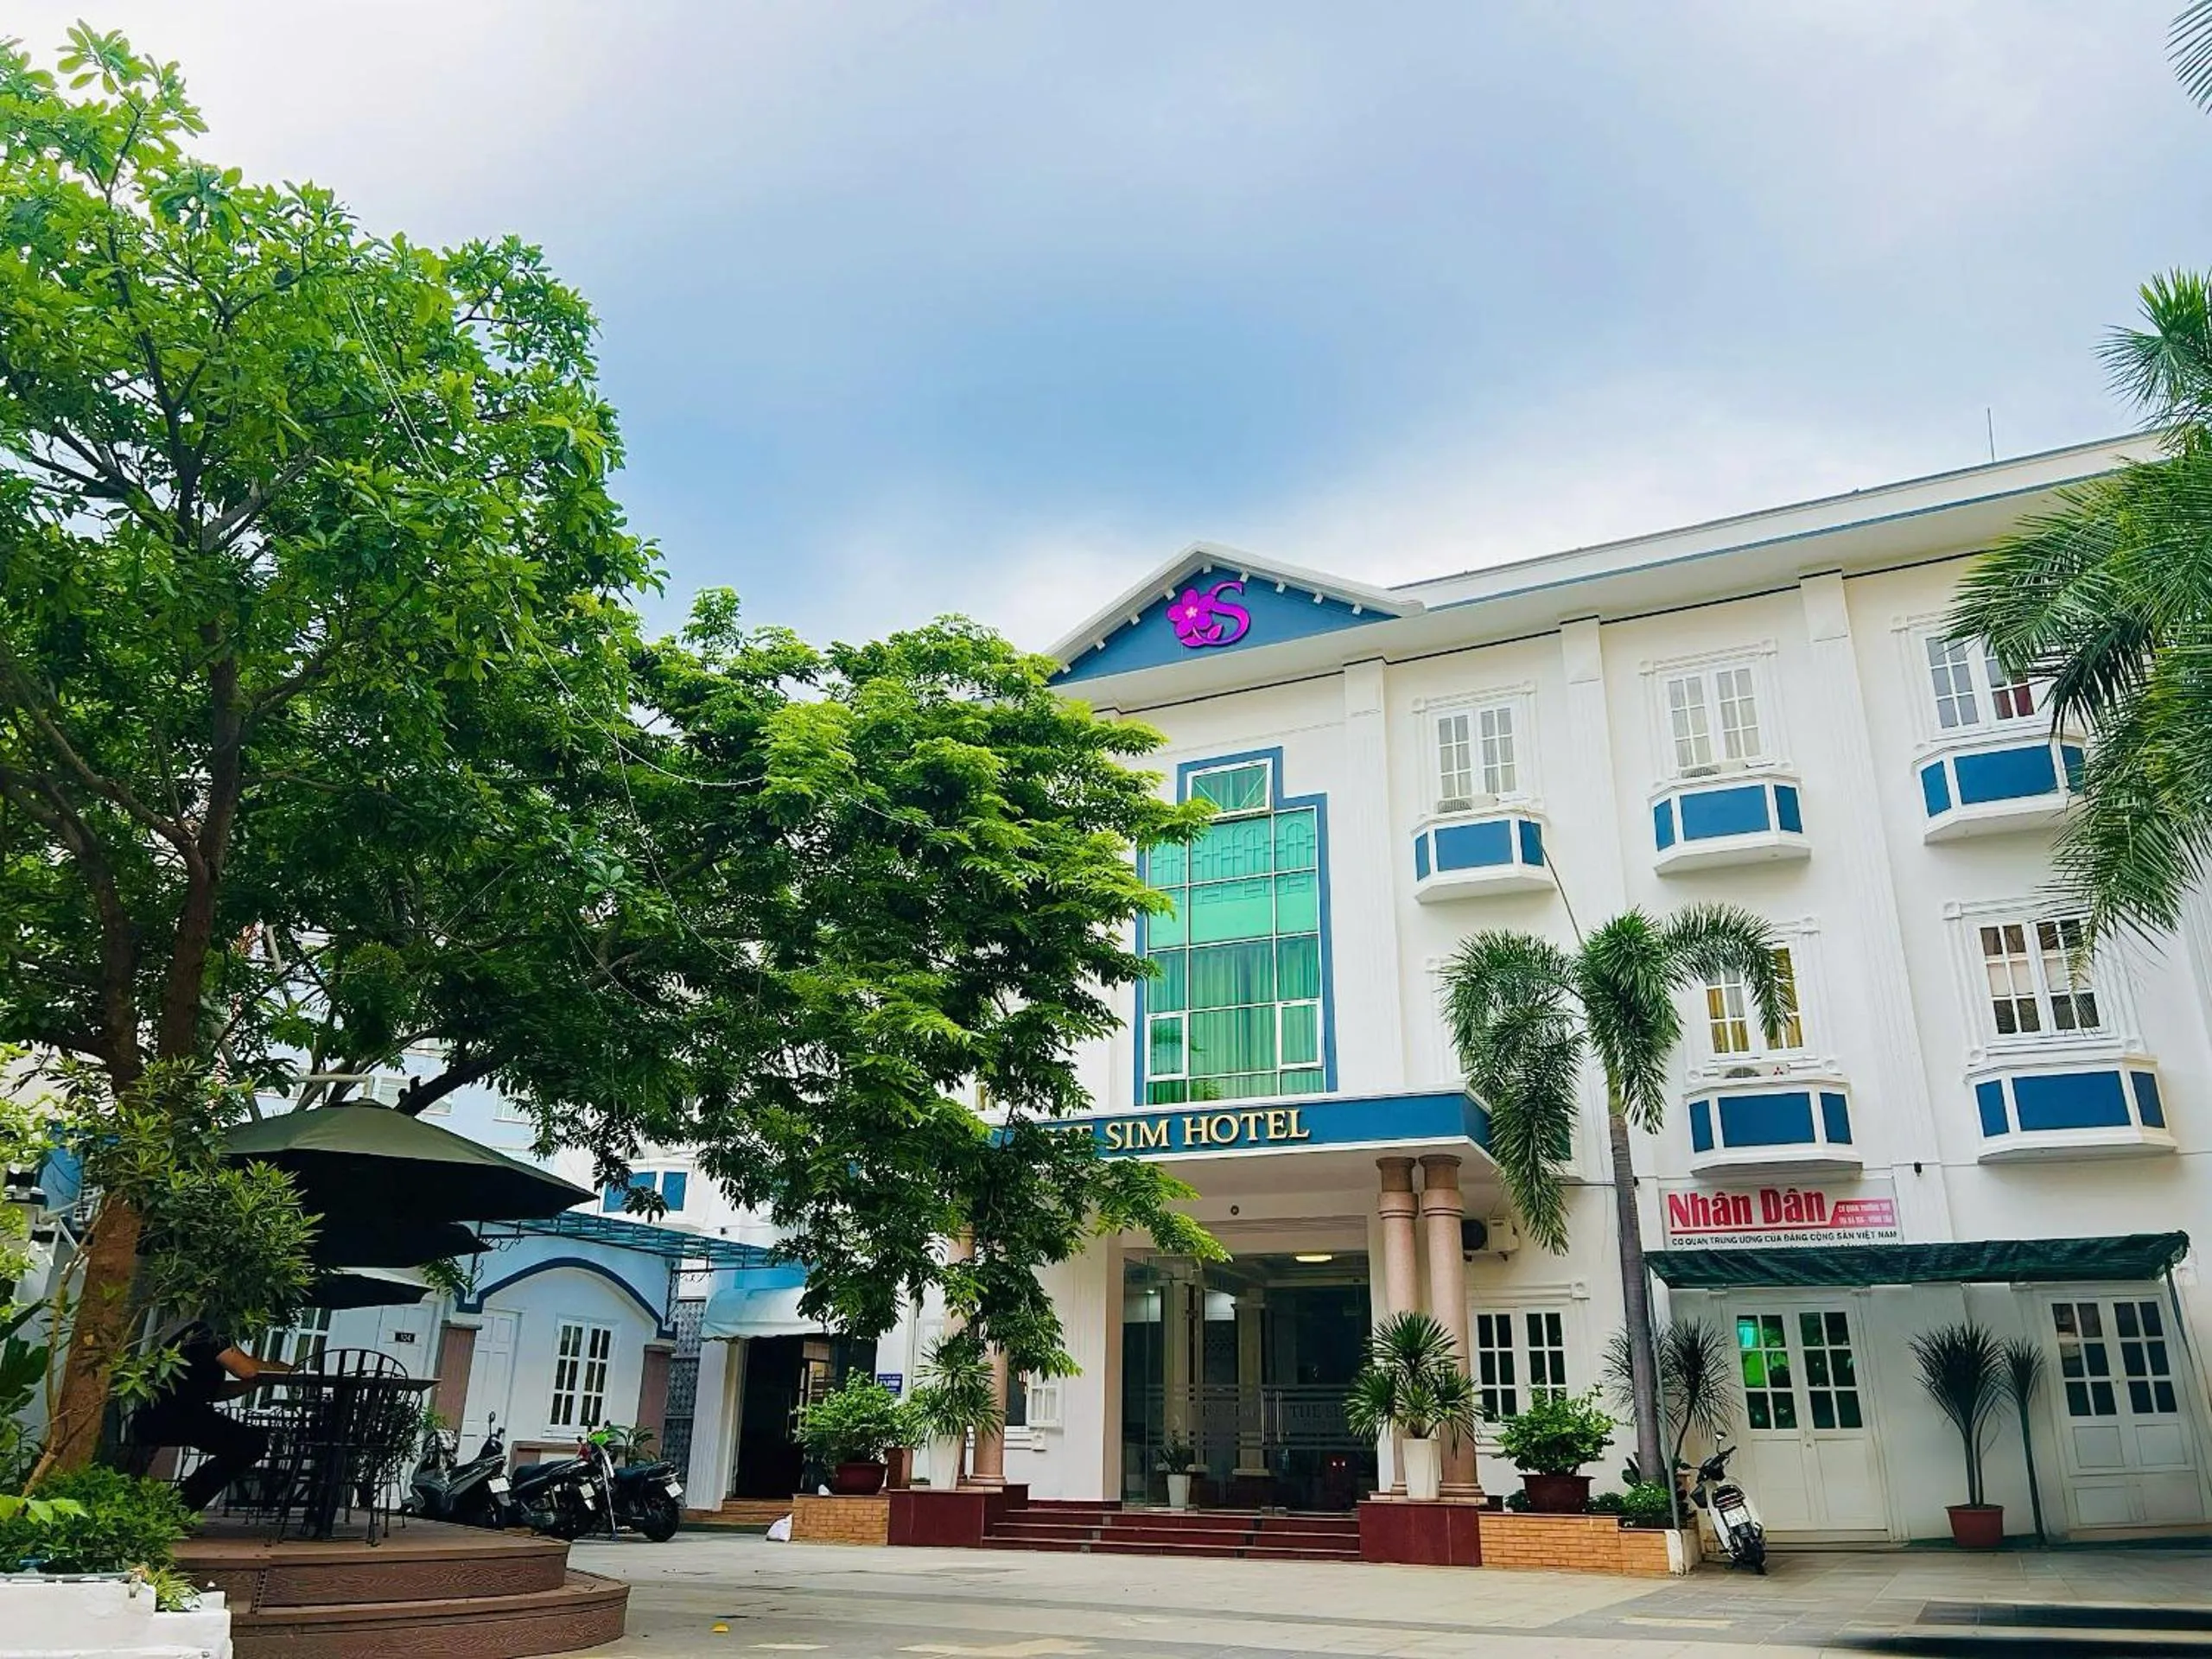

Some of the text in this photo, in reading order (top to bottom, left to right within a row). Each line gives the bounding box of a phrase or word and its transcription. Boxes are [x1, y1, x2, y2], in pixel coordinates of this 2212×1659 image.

[1105, 1118, 1170, 1151] SIM
[1182, 1109, 1311, 1146] HOTEL
[1668, 1187, 1827, 1228] Nhân Dân
[1878, 1230, 1897, 1238] NAM
